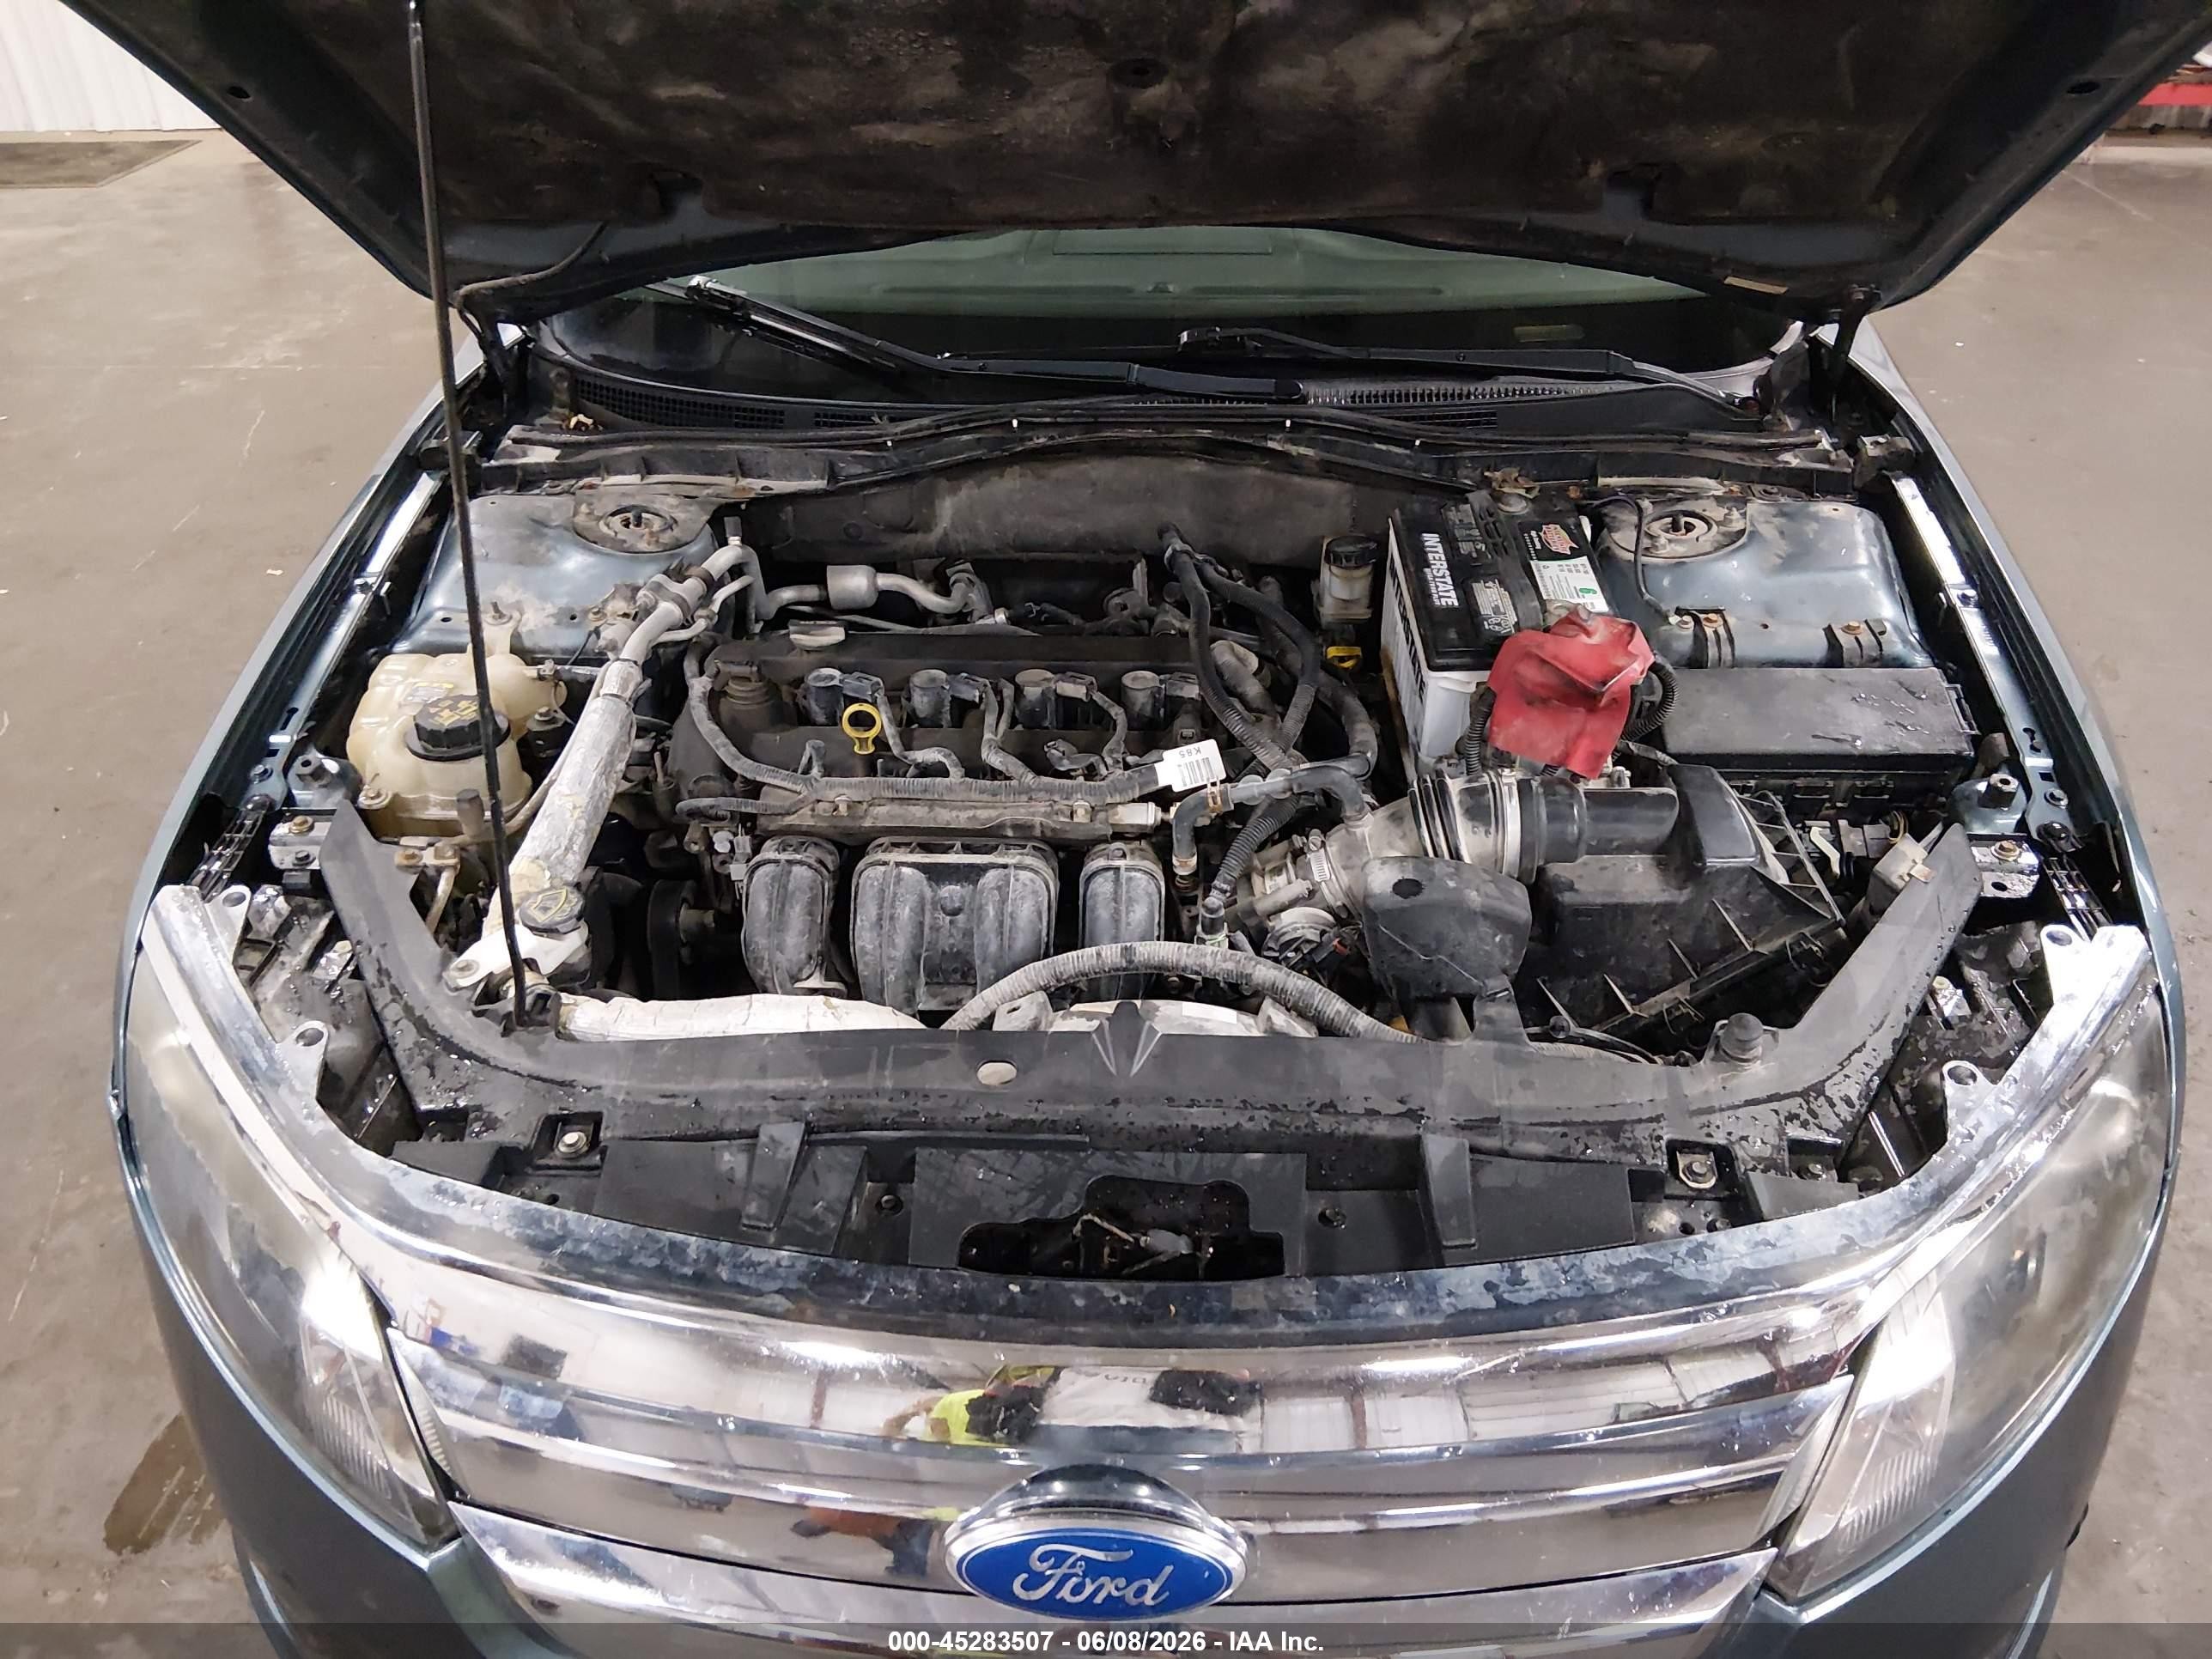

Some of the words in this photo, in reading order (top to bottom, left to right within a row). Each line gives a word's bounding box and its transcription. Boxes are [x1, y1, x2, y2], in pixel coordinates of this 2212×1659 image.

[1421, 532, 1459, 606] INTERSTATE
[1389, 553, 1426, 704] INTERSTATE
[1179, 746, 1201, 758] K85
[1012, 1543, 1174, 1607] Ford
